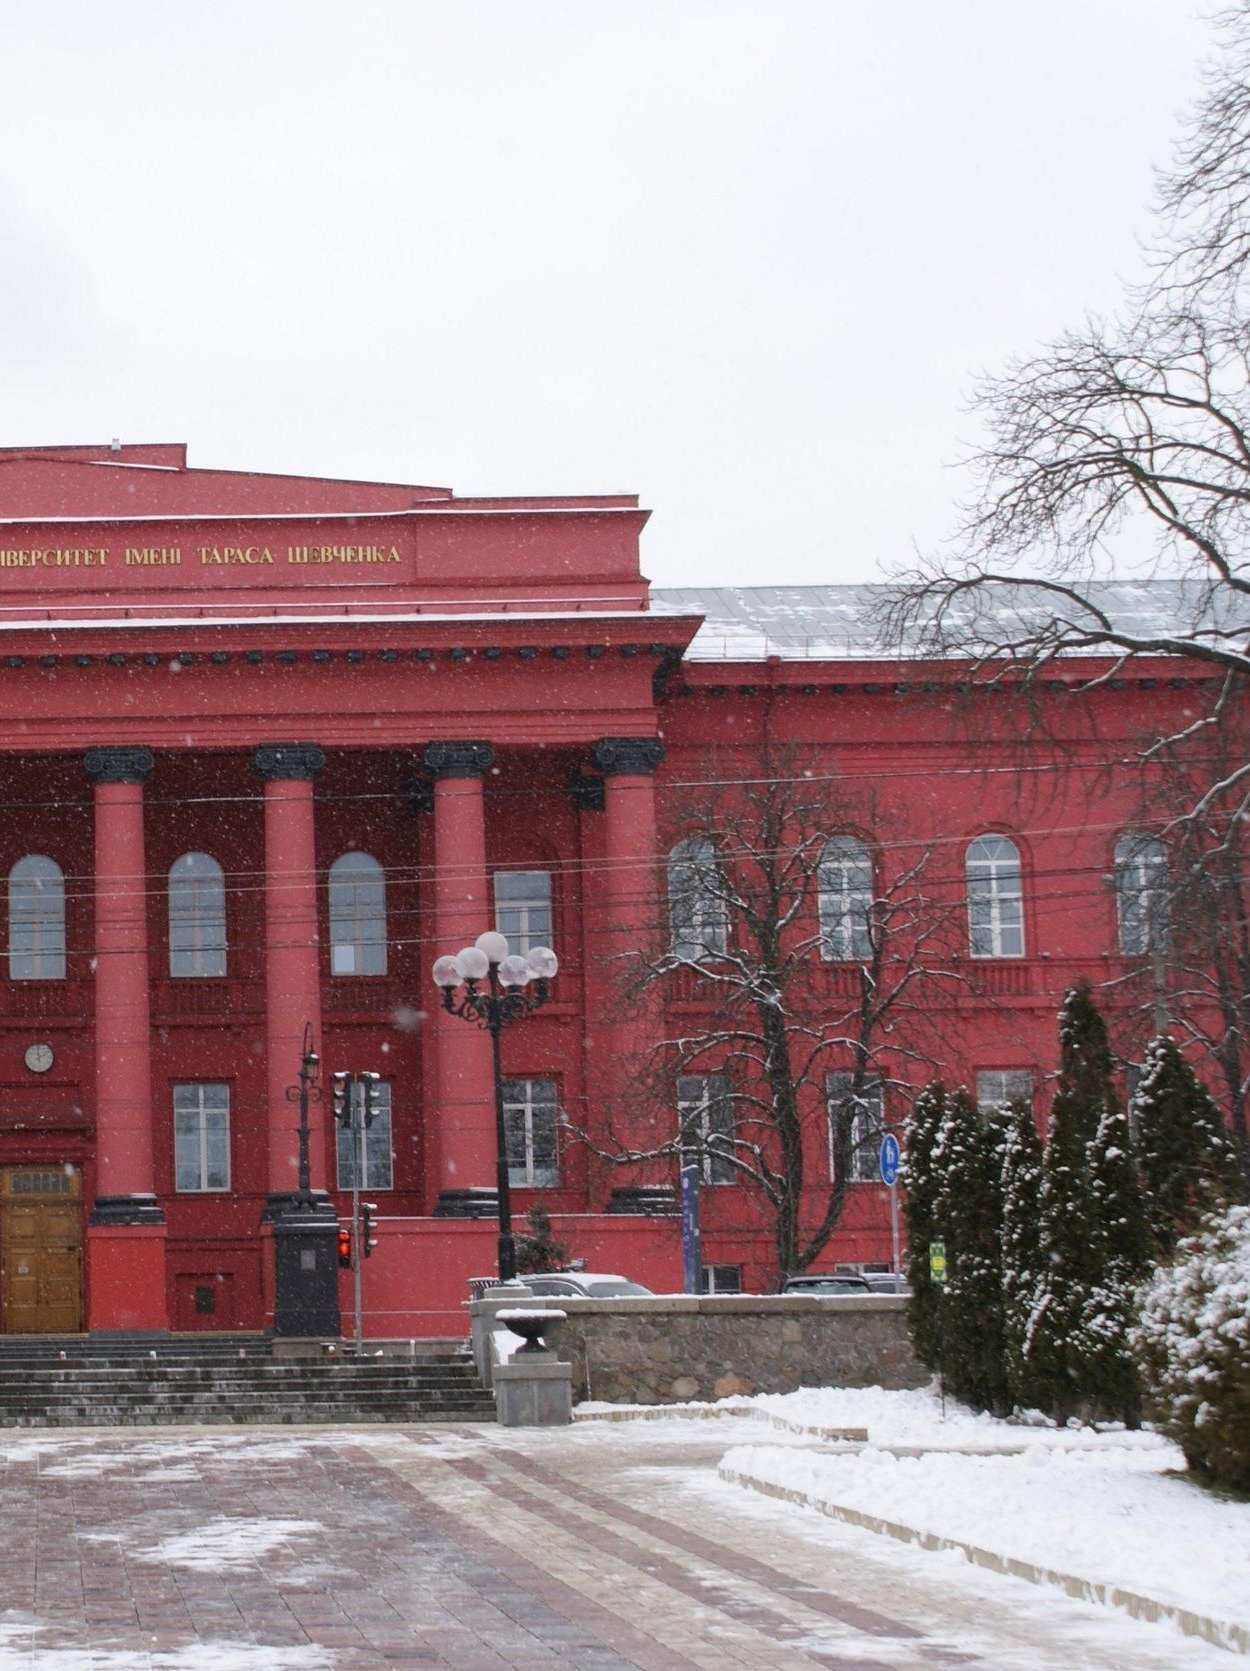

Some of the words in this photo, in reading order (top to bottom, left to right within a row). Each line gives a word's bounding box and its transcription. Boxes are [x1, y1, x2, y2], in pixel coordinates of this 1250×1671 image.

[125, 547, 181, 566] ІМЕНІ
[197, 546, 274, 565] ТАРАСА
[288, 545, 401, 563] ШЕВЧЕНКА
